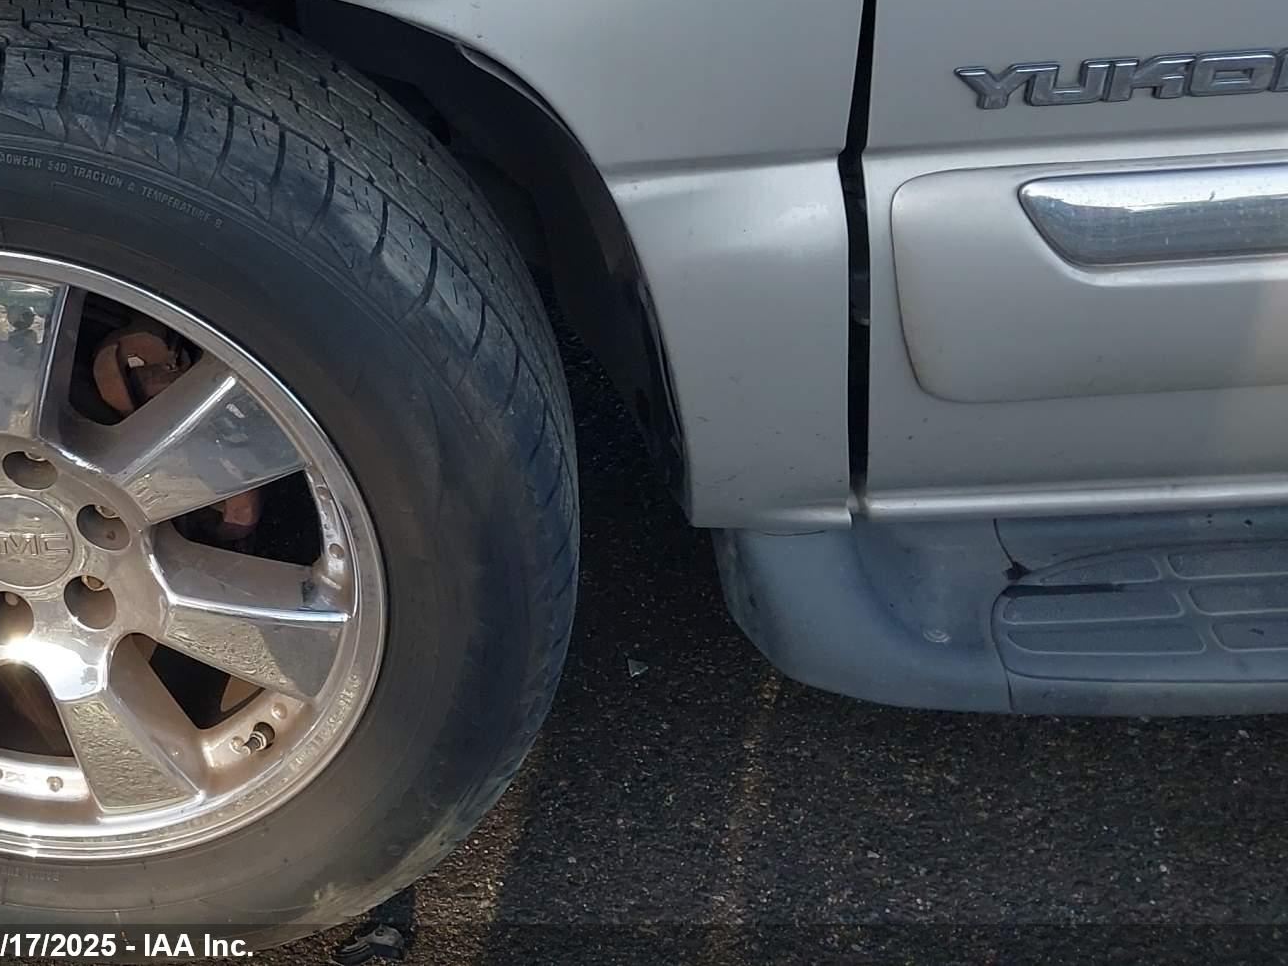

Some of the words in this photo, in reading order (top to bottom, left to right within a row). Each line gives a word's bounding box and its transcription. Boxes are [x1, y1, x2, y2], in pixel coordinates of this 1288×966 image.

[953, 47, 1288, 110] YUKO
[73, 165, 123, 189] TRACTION
[127, 181, 136, 193] A
[141, 185, 211, 221] TEMPERATURE
